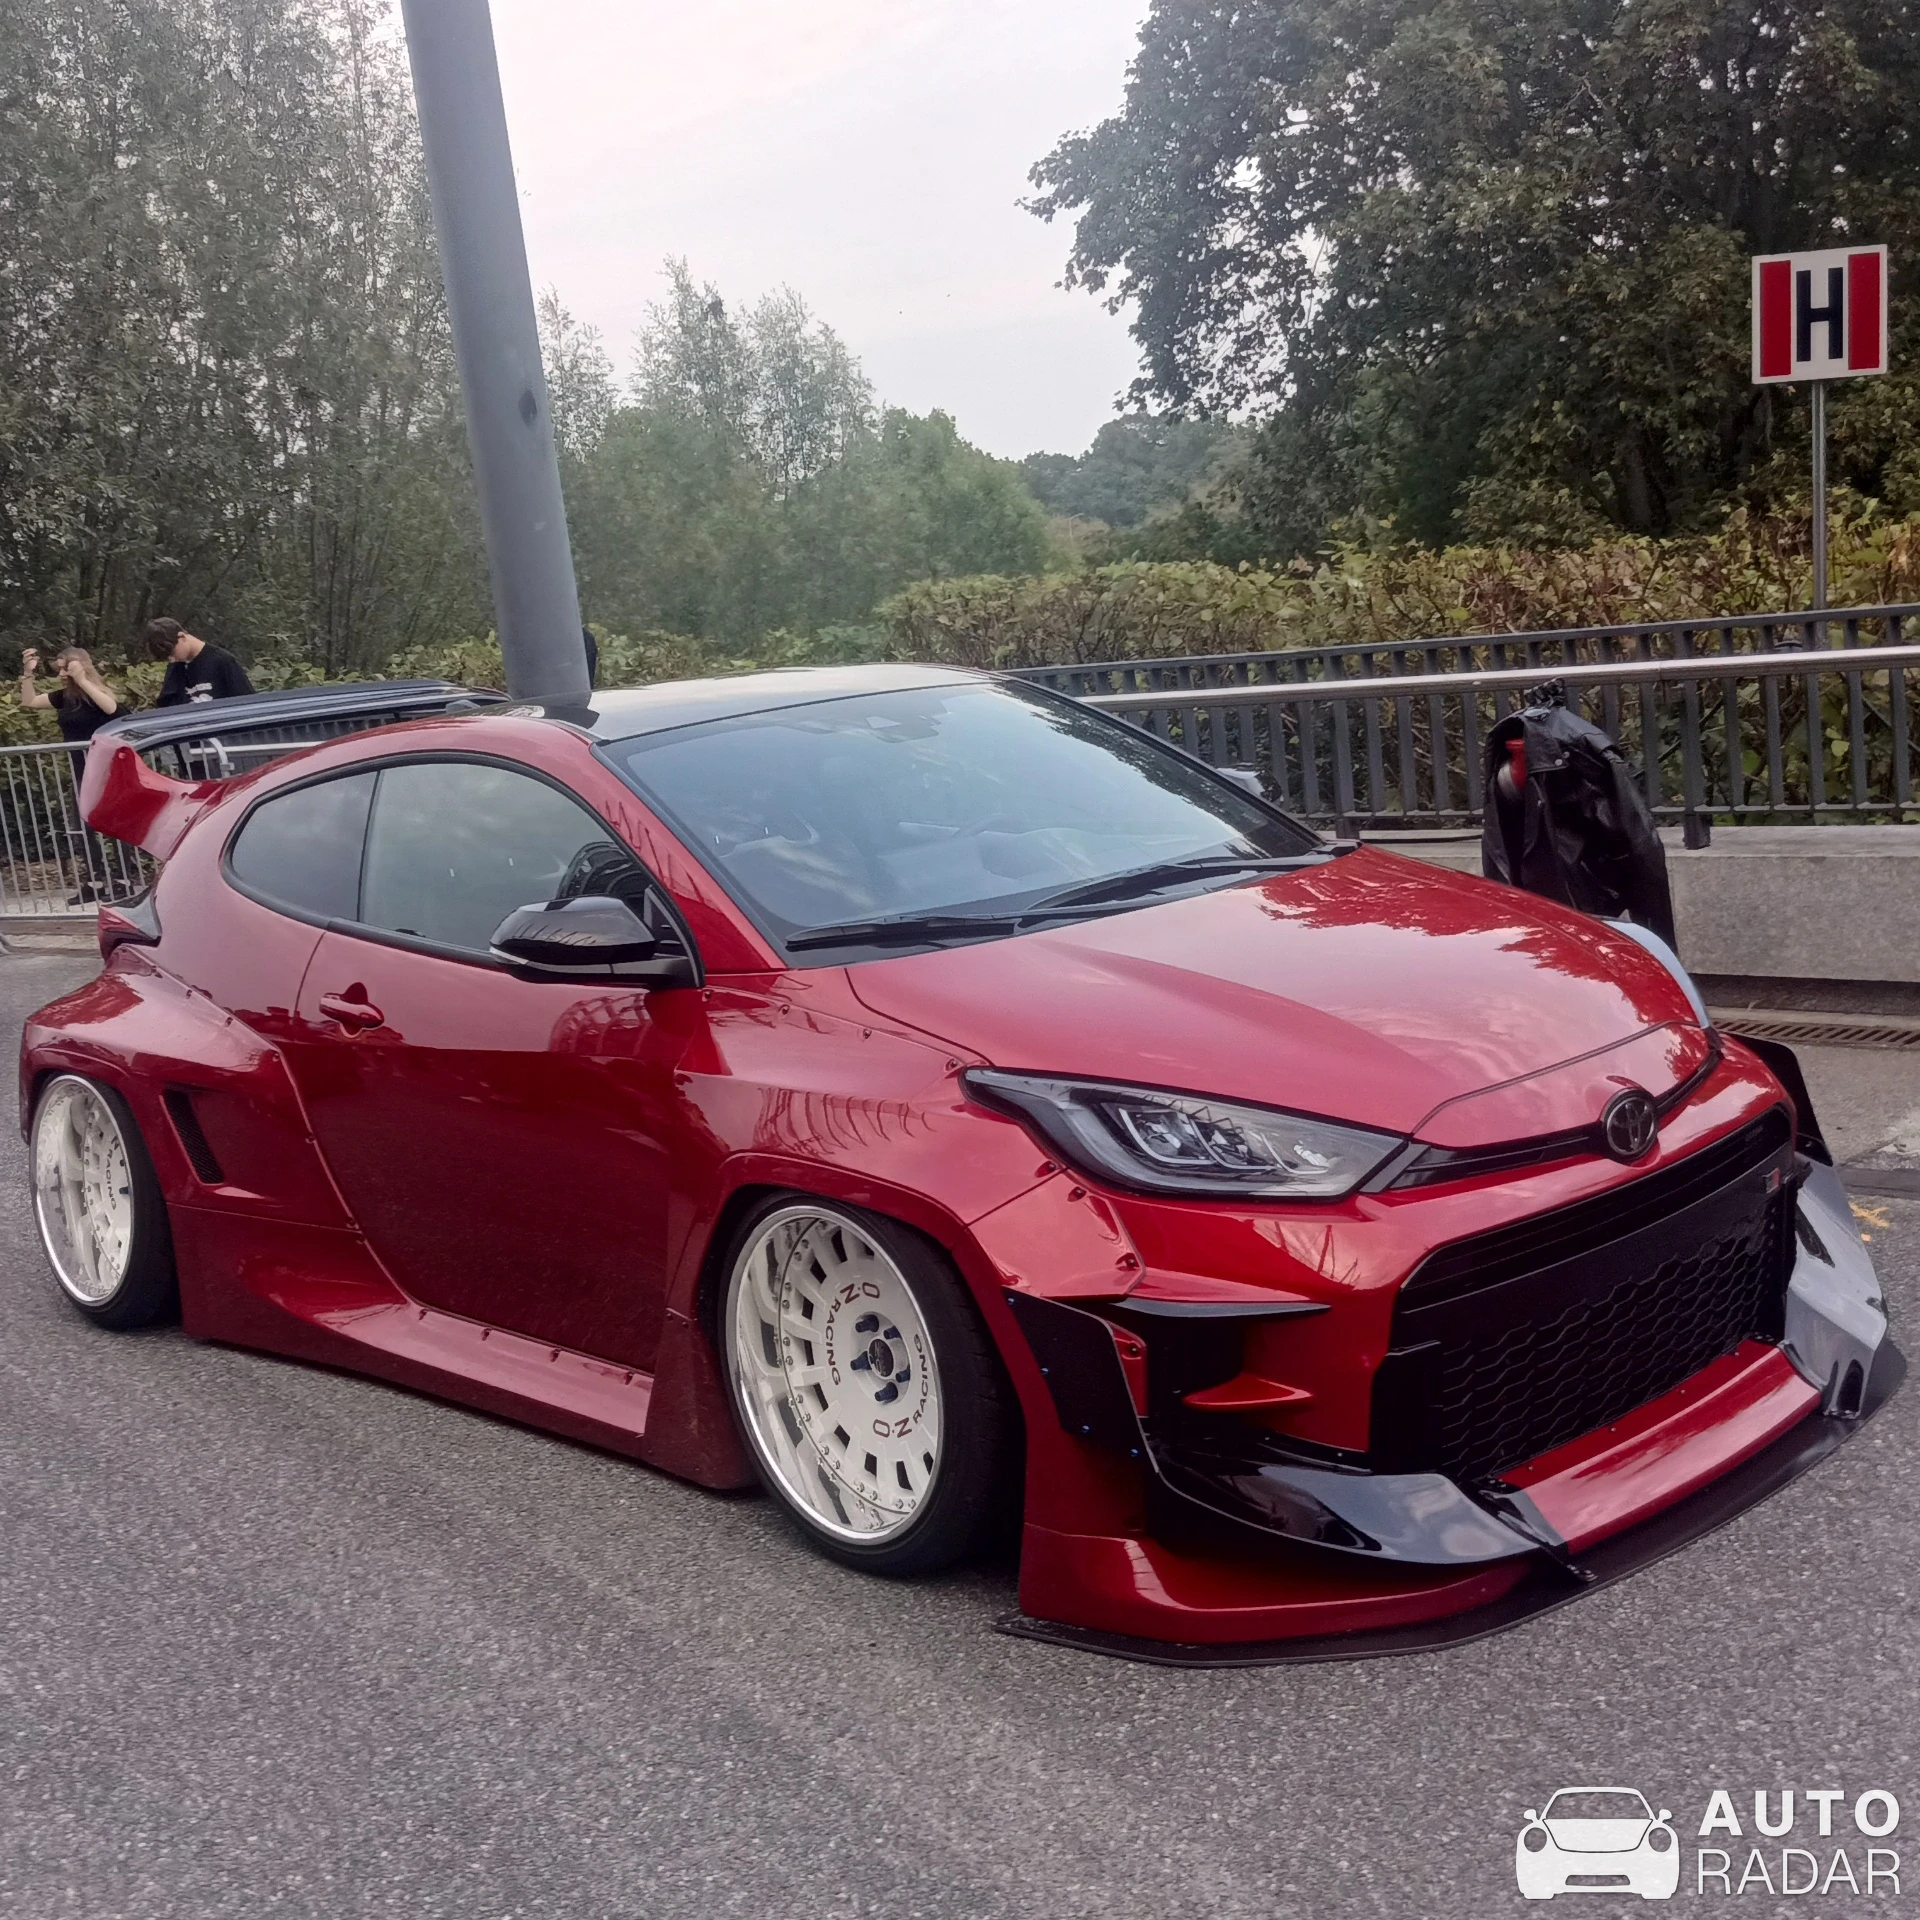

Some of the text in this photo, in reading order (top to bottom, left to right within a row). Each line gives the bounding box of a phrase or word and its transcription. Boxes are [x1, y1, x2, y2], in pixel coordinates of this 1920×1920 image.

[1796, 267, 1843, 362] H
[824, 1297, 841, 1386] RACING
[911, 1333, 928, 1424] RACING
